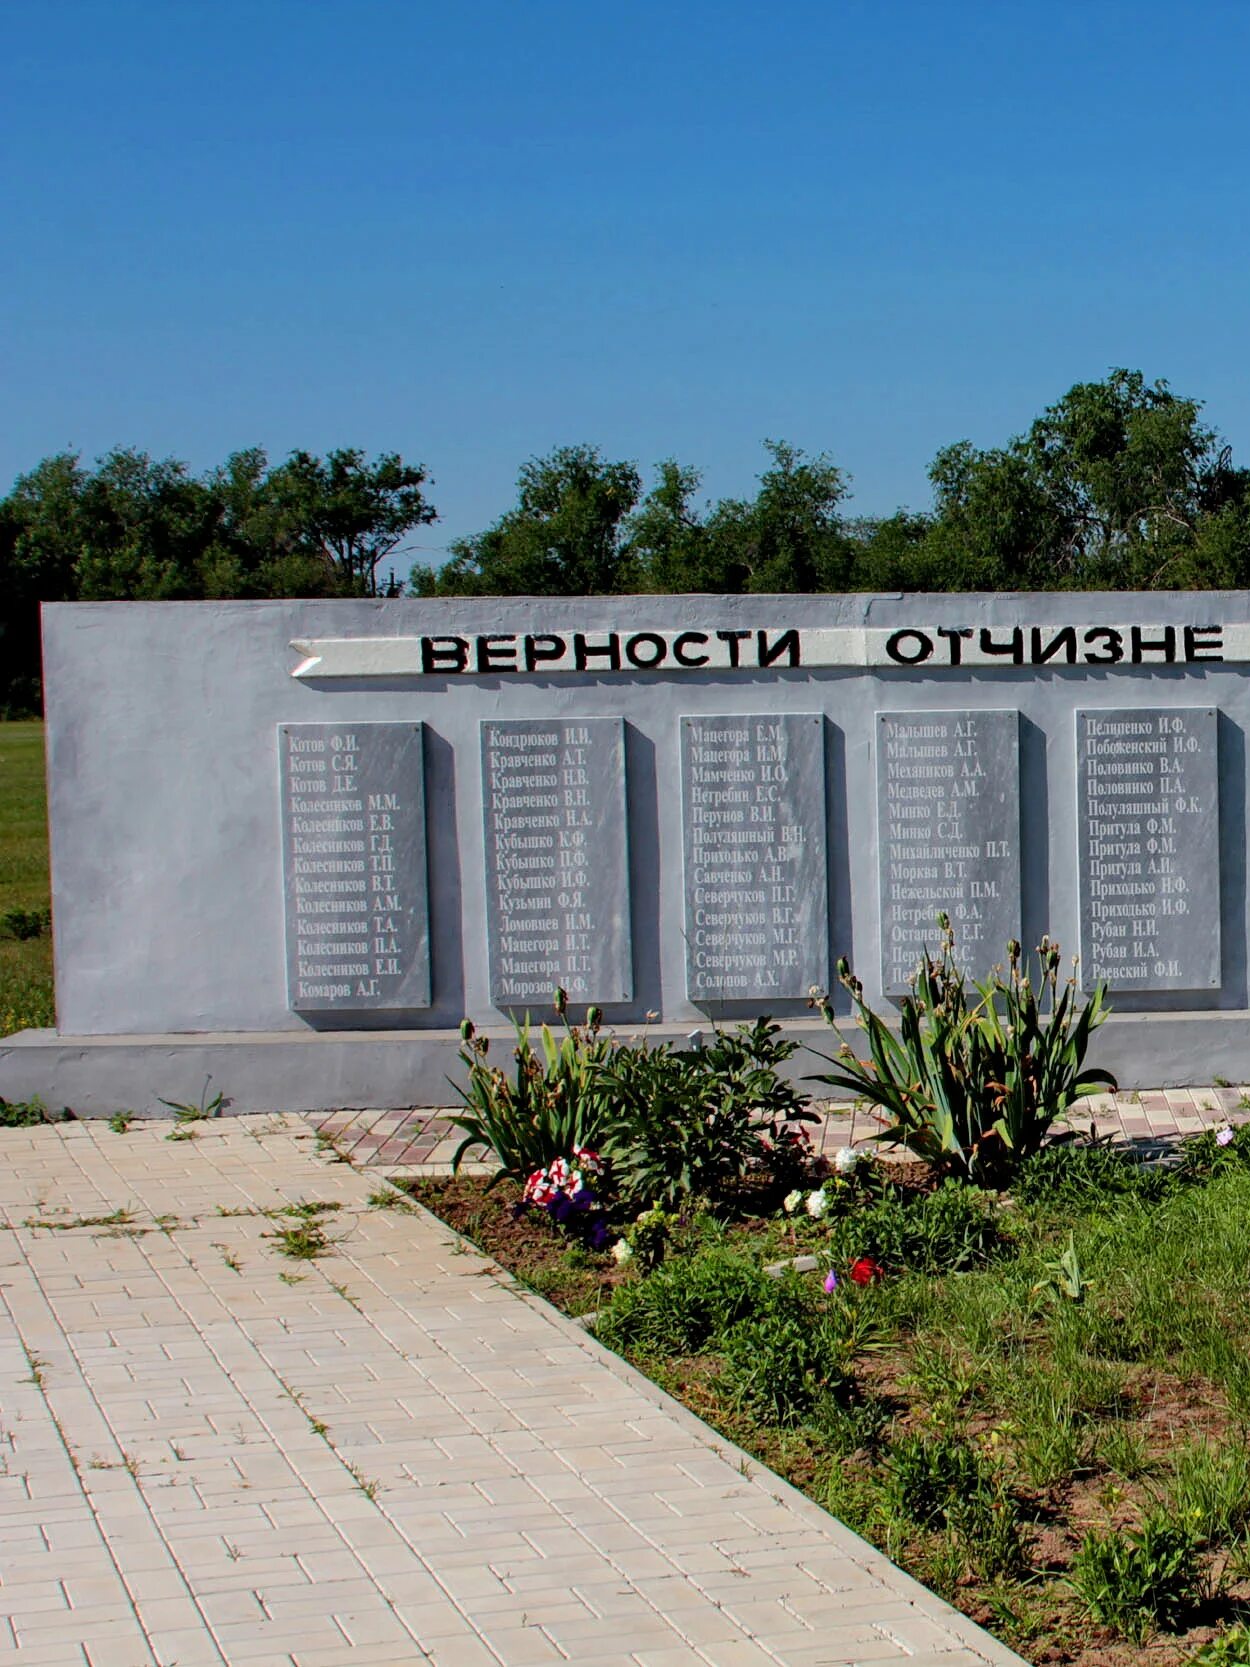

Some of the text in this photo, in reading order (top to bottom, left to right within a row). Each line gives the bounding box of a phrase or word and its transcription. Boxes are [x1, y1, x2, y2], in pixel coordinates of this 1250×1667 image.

[421, 630, 802, 674] ВЕРНОСТИ
[887, 626, 1223, 665] ОТЧИЗНЕ
[692, 725, 784, 746] Мацегора Е.М.
[887, 721, 977, 738] Малышев А.Г.
[289, 736, 324, 752] Котов
[489, 730, 558, 751] Кондрюков
[887, 741, 977, 758] Малышев А.Г.
[1087, 738, 1167, 755] Побоженский
[290, 755, 358, 772] Котов С.Я.
[491, 749, 586, 772] Кравченко А.Т.
[961, 761, 986, 777] А.А.
[1088, 757, 1184, 775] Половинко В.А.
[291, 775, 357, 792] Котов Д.Е.
[492, 772, 557, 792] Кравченко
[888, 781, 979, 799] Медведев А.М.
[1088, 780, 1153, 795] Половинко
[291, 794, 400, 812] Колесников М.М.
[492, 793, 558, 813] Кравченко
[692, 785, 781, 806] Нетребин Е.С.
[889, 802, 961, 820] Минко Е.Д.
[1088, 797, 1202, 819] Полуляшный Ф.К.
[292, 814, 395, 833] Колесников Е.В.
[494, 814, 560, 833] Кравченко
[890, 822, 963, 840] Минко С.Д.
[1089, 818, 1176, 840] Притула Ф.М.
[495, 831, 587, 853] Кубышко К.Ф.
[693, 827, 774, 847] Полуляшный
[693, 847, 789, 867] Приходько А.В.
[1089, 838, 1176, 859] Притула Ф.М.
[496, 854, 554, 873] Кубышко
[891, 862, 967, 883] Морква В.Т.
[1090, 860, 1141, 879] Притула
[295, 875, 395, 894] Колесников В.Т.
[497, 874, 555, 893] Кубышко
[694, 868, 752, 883] Савченко
[695, 888, 765, 907] Северчуков
[891, 882, 963, 899] Нежельской
[1091, 880, 1155, 900] Приходько
[296, 895, 402, 913] Колесников А.М.
[499, 892, 586, 914] Кузьмин Ф.Я.
[1092, 901, 1156, 921] Приходько
[297, 917, 397, 935] Колесников Т.А.
[695, 907, 794, 928] Северчуков В.Г.
[1091, 921, 1126, 941] Рубан
[1092, 943, 1127, 963] Рубан
[501, 959, 560, 977] Мацегора
[298, 979, 380, 1000] Комаров А.Г.
